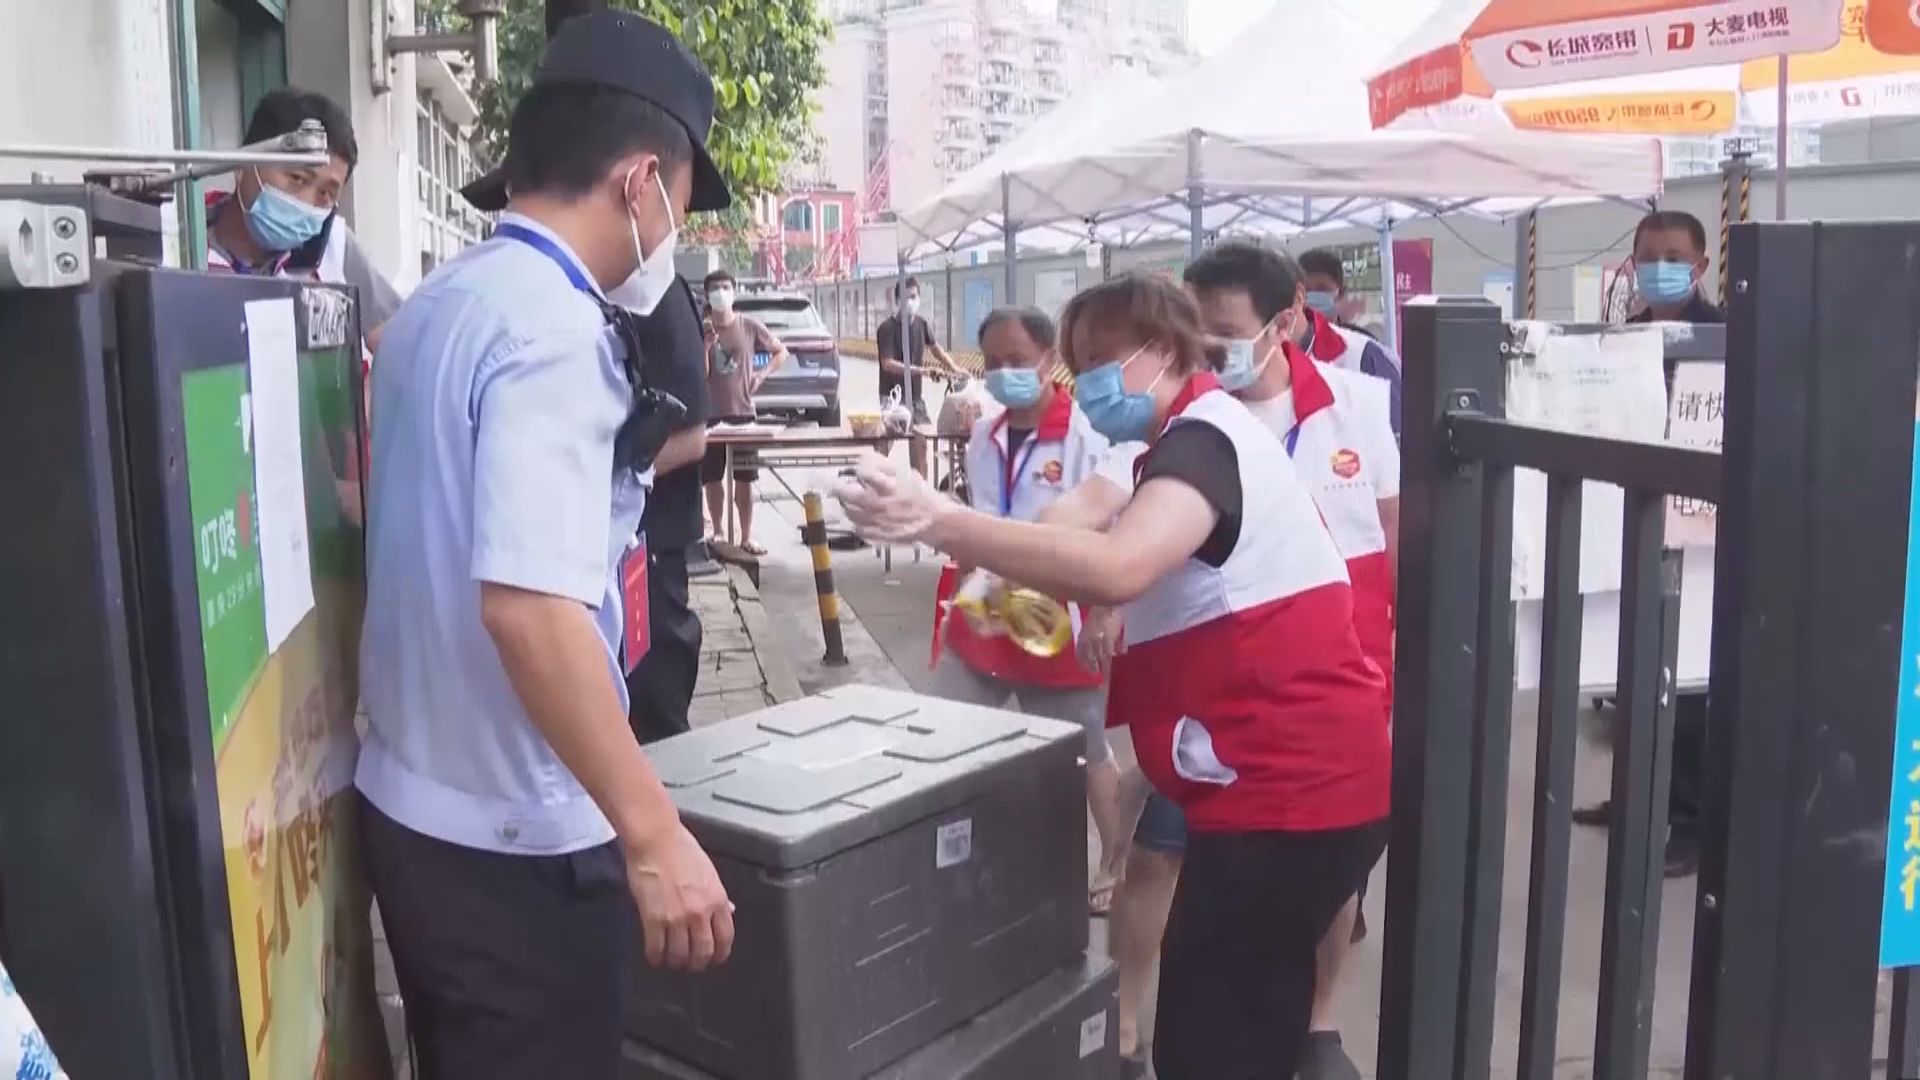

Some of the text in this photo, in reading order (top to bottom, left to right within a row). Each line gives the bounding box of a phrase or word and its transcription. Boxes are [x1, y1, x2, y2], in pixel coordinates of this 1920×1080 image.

[1705, 6, 1789, 37] 大麦电视
[1548, 29, 1636, 57] 长城宽带
